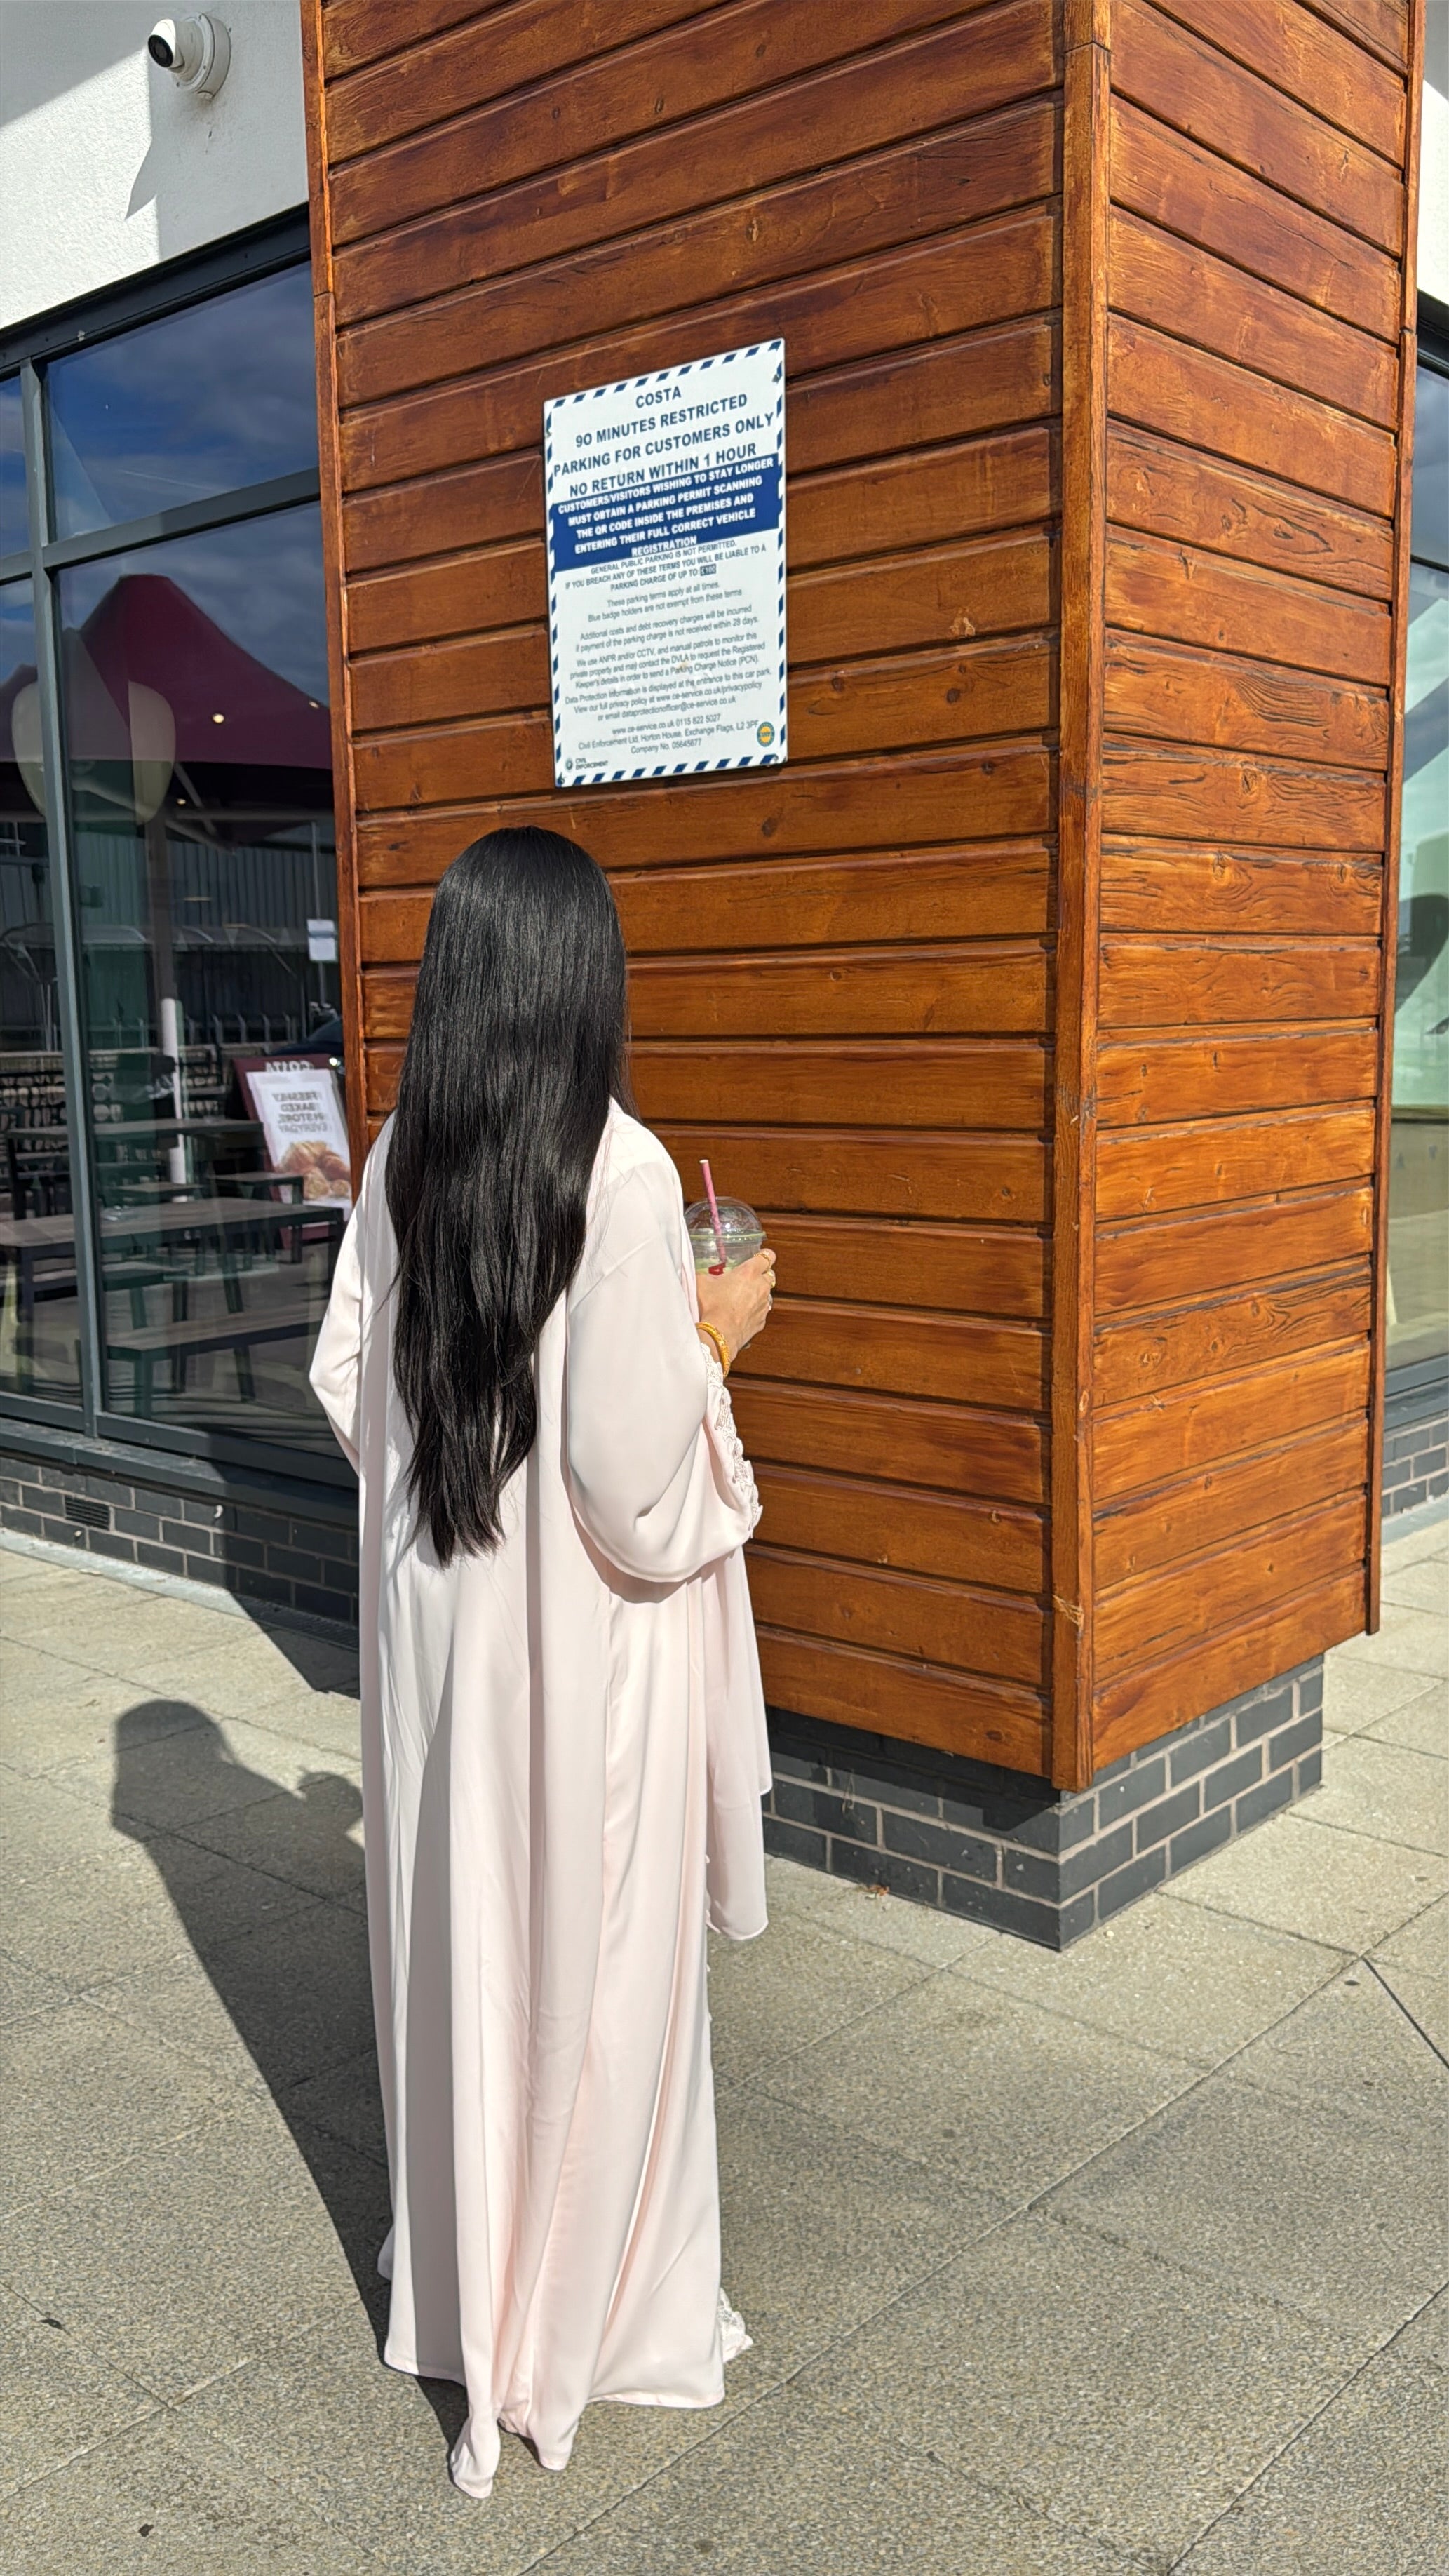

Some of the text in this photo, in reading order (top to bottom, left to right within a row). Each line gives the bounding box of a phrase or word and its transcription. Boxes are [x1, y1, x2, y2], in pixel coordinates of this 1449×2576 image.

[635, 386, 681, 408] COSTA
[576, 394, 746, 447] 90 MINUTES RESTRICTED
[554, 412, 773, 476] PARKING FOR CUSTOMERS ONLY
[558, 457, 773, 514] CUSTOMERS/VISITORS WISHING TO STAY LONGER
[570, 443, 755, 497] NO RETURN WITHIN 1 HOUR
[568, 476, 762, 525] MUST OBTAIN A PARKING PERMIT SCANNING
[577, 493, 753, 538] THE QR CODE INSIDE THE PREMISES AND
[575, 508, 755, 553] ENTERING THEIR FULL CORRECT VEHICLE
[631, 535, 696, 557] REGISTRATION
[586, 575, 610, 586] BREACH
[636, 565, 656, 575] THESE
[659, 561, 680, 570] TERMS
[682, 558, 695, 567] YOU
[697, 555, 713, 563] WILL
[714, 552, 722, 561] BE
[725, 547, 748, 558] LIABLE
[750, 545, 760, 554] TO
[591, 563, 619, 574] GENERAL
[621, 558, 642, 568] PUBLIC
[645, 552, 673, 562] PARKING
[682, 547, 695, 556] NOT
[698, 539, 736, 553] PERMITTED.
[610, 579, 638, 590] PARKING
[640, 574, 666, 586] CHARGE
[668, 572, 675, 580] OF
[626, 595, 648, 605] parking
[668, 587, 684, 597] apply
[580, 629, 607, 640] Additional
[626, 624, 636, 633] and
[638, 622, 651, 631] debt
[652, 619, 678, 628] recovery
[680, 614, 703, 624] charges
[705, 610, 715, 619] will
[727, 604, 751, 615] incurred
[602, 611, 619, 619] badge
[621, 607, 642, 615] holders
[666, 598, 688, 608] exempt
[706, 593, 722, 601] these
[581, 641, 604, 652] payment
[605, 638, 612, 648] of
[624, 635, 645, 645] parking
[646, 631, 666, 640] charge
[686, 623, 711, 633] received
[732, 617, 740, 626] 28
[599, 654, 616, 663] ANPR
[657, 645, 668, 655] and
[670, 642, 691, 651] manual
[693, 639, 713, 650] patrols
[722, 634, 744, 643] monitor
[570, 671, 588, 680] private
[589, 666, 611, 676] property
[625, 662, 637, 671] may
[638, 659, 659, 668] contact
[671, 653, 689, 663] DVLA
[697, 649, 720, 659] request
[732, 641, 765, 655] Registered
[600, 676, 618, 685] details
[670, 665, 692, 673] Parking
[694, 662, 716, 671] Charge
[578, 741, 590, 750] Civil
[591, 737, 627, 748] Enforcement
[685, 727, 714, 736] Exchange
[736, 721, 744, 730] L2
[675, 717, 691, 727] 0115
[692, 716, 703, 724] 822
[706, 713, 720, 723] 5027
[631, 745, 658, 753] Company
